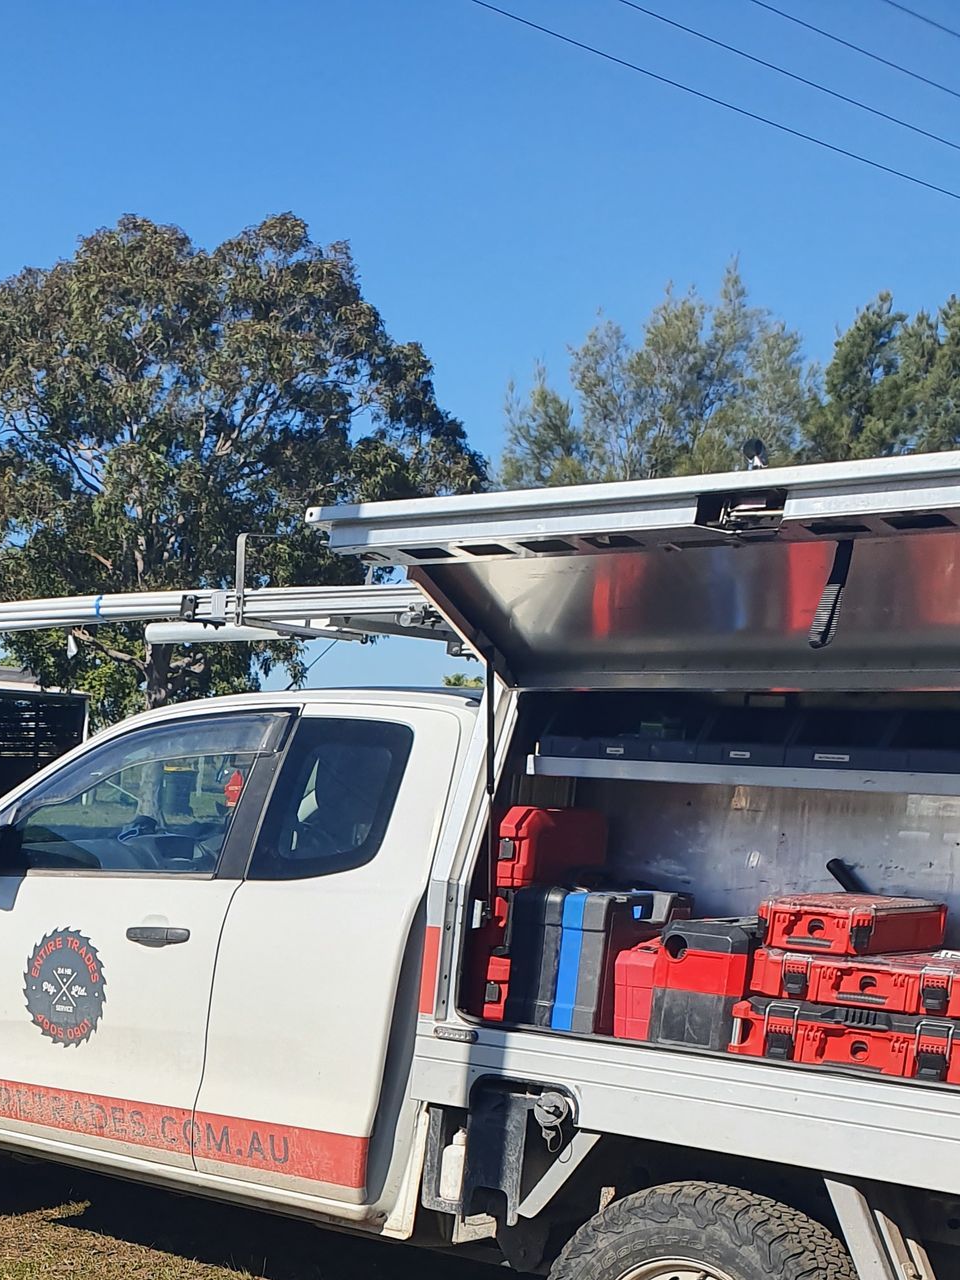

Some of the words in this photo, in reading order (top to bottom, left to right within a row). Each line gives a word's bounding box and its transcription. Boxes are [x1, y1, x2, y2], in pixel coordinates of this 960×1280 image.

[31, 937, 63, 978] ENTIRE
[66, 936, 100, 983] TRADES
[57, 967, 64, 975] 24
[64, 968, 72, 976] HR
[35, 1013, 64, 1039] 4905
[66, 1018, 92, 1040] 0901
